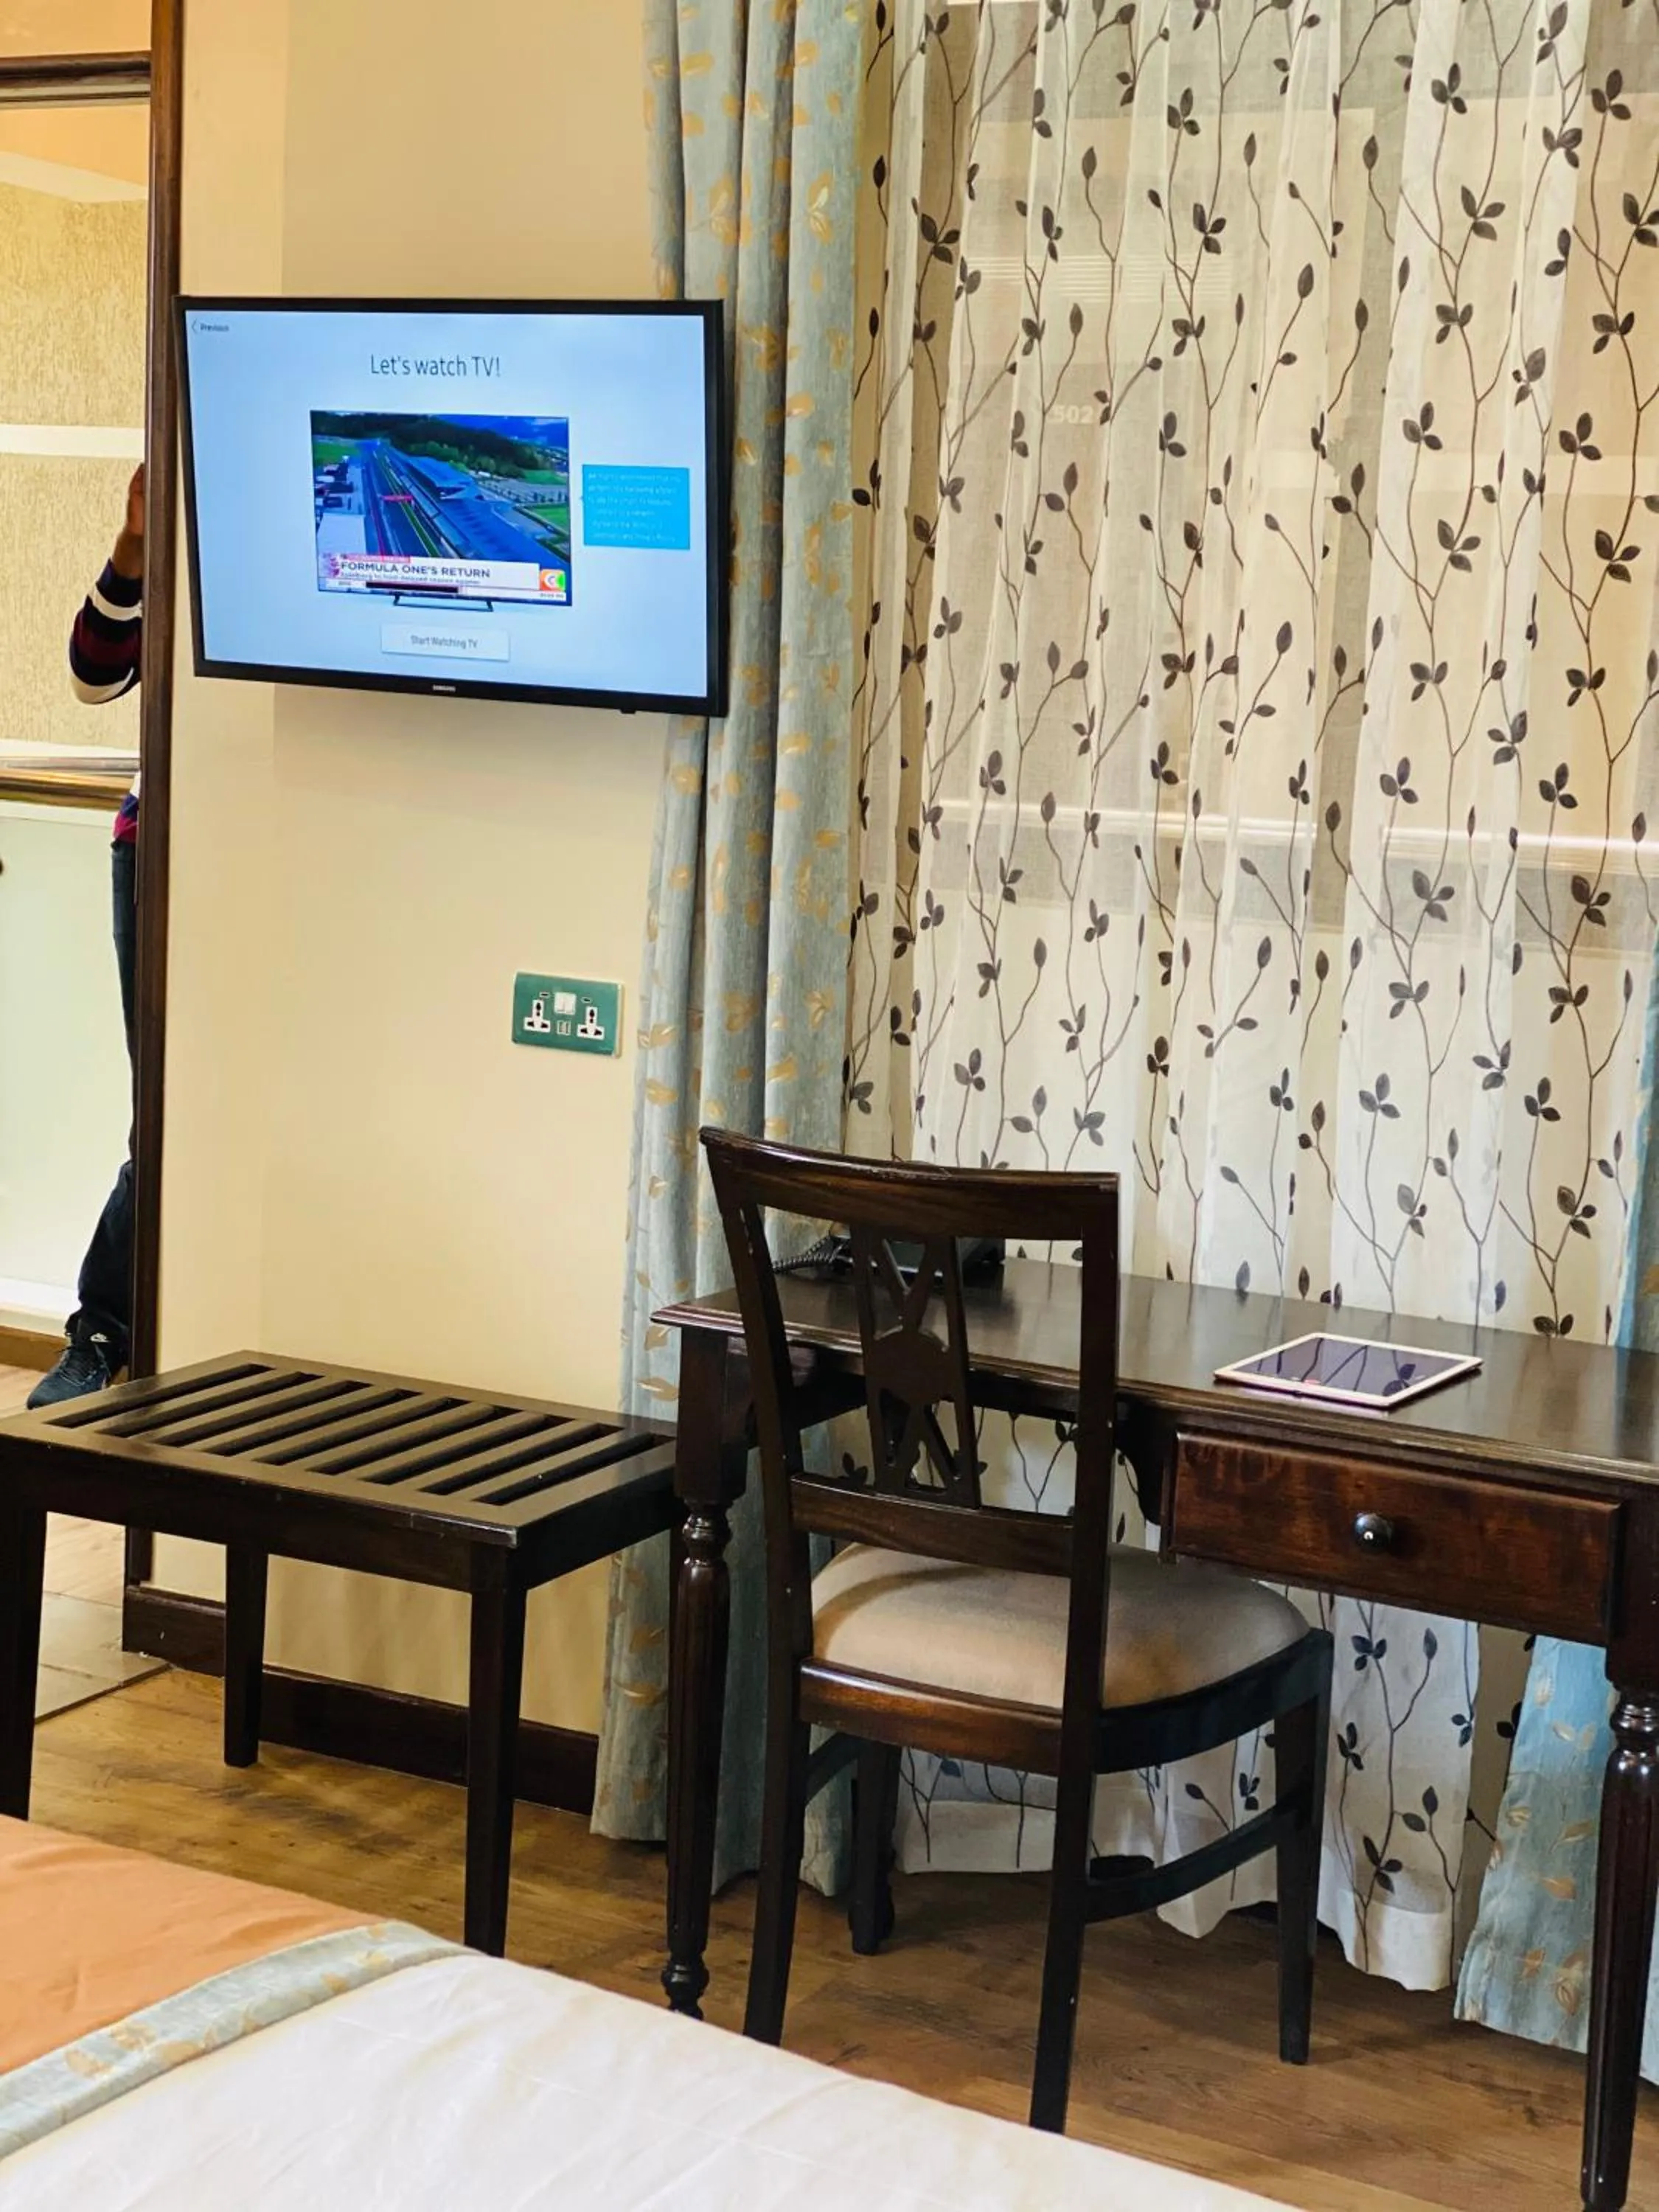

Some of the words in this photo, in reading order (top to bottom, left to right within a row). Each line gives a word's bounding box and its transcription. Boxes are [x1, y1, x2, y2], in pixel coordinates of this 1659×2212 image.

[371, 354, 411, 375] Let's
[415, 355, 467, 376] watch
[472, 356, 501, 378] TV!
[341, 561, 399, 573] FORMULA
[402, 565, 438, 575] ONE'S
[442, 566, 491, 578] RETURN
[411, 635, 430, 646] Start
[467, 639, 479, 648] TV
